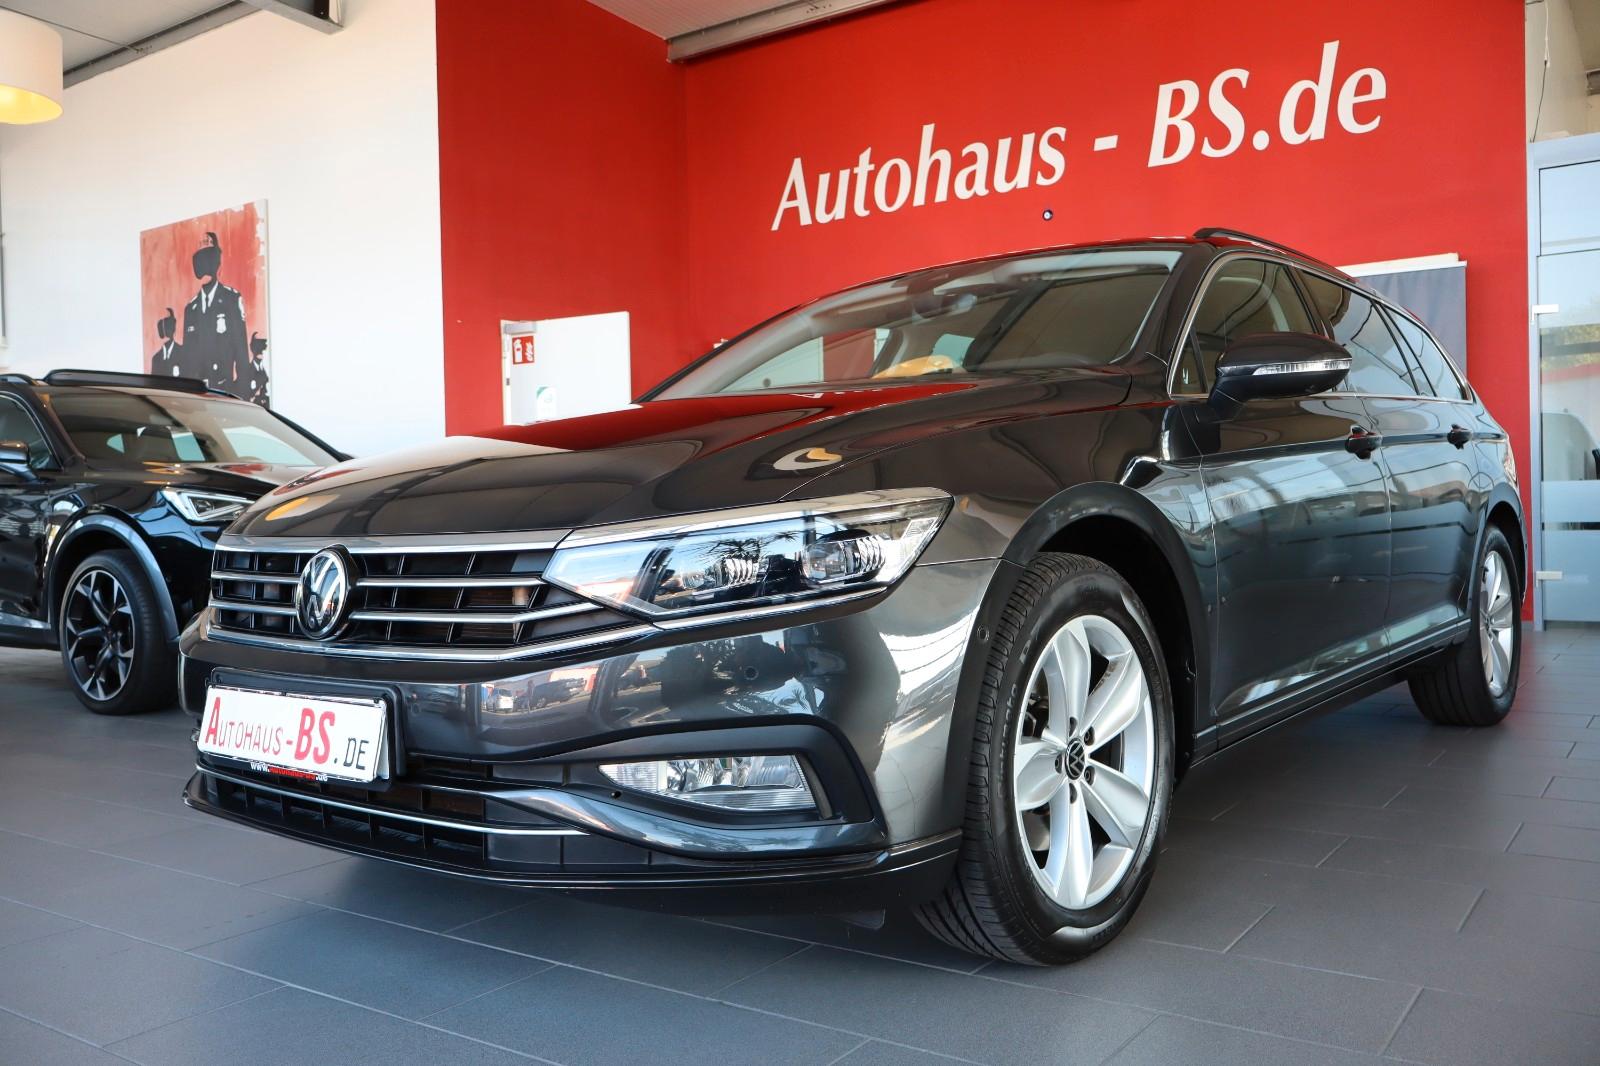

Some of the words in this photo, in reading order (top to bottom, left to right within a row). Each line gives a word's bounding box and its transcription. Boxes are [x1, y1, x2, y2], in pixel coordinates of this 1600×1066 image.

[770, 123, 1067, 232] Autohaus
[1093, 134, 1119, 152] -
[1147, 39, 1388, 168] BS.de
